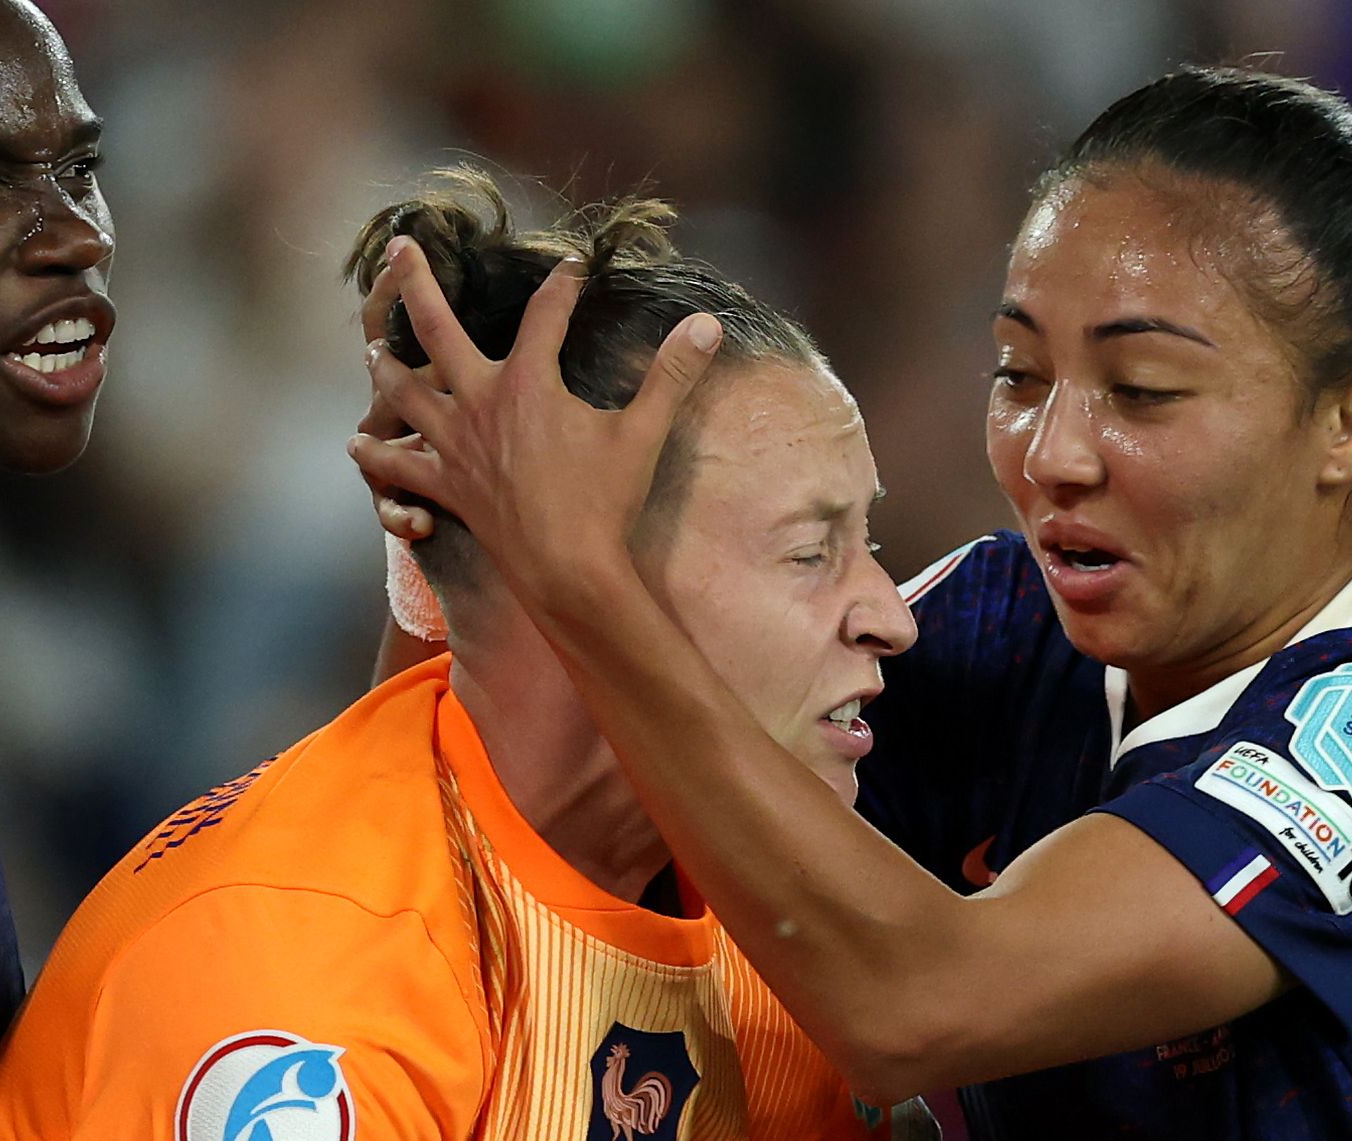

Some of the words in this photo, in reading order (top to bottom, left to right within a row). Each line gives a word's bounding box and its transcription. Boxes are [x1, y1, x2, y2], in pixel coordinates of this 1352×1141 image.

[1234, 746, 1270, 765] UEFA
[1215, 760, 1345, 858] FOUNDATION
[1278, 826, 1296, 840] for
